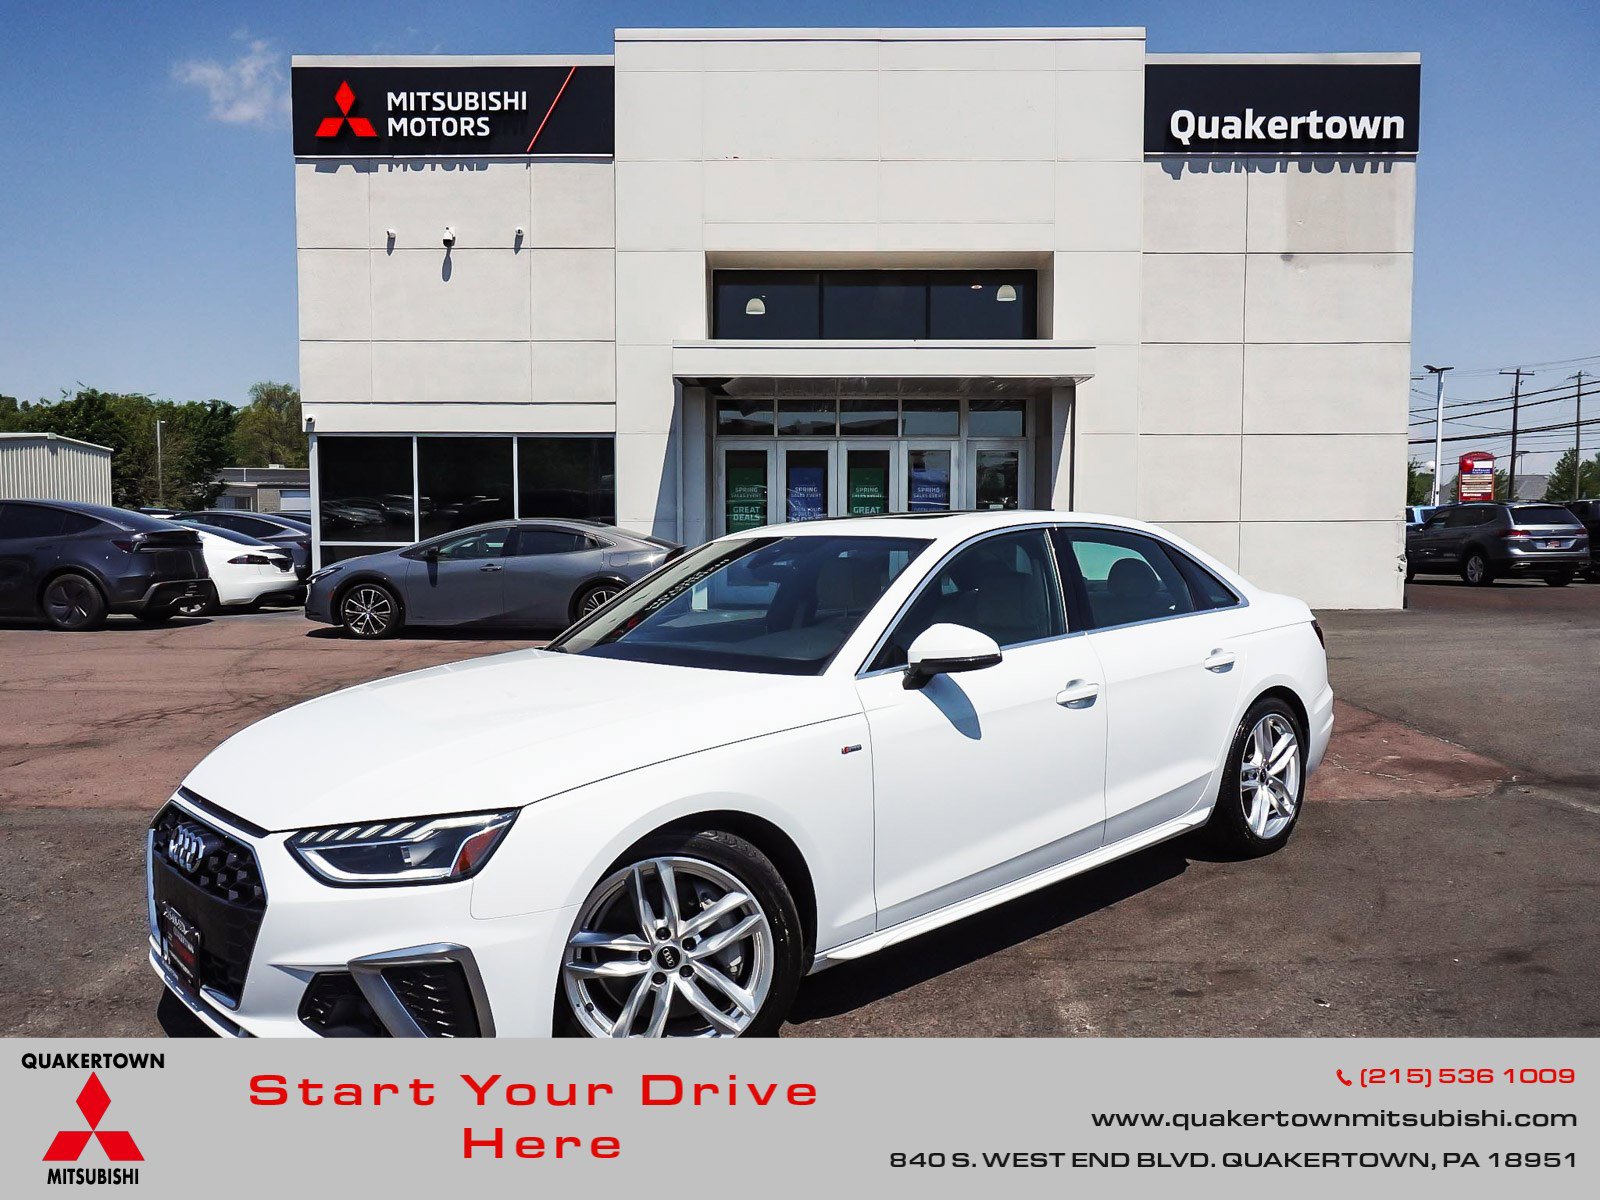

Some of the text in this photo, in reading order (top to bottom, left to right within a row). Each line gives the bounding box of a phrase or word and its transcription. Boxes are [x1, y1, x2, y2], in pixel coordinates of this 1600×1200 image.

[387, 91, 528, 112] MITSUBISHI
[387, 116, 491, 137] MOTORS
[1170, 108, 1406, 146] Quakertown
[733, 506, 760, 514] GREAT
[733, 513, 760, 521] DEALS
[853, 506, 881, 514] GREAT
